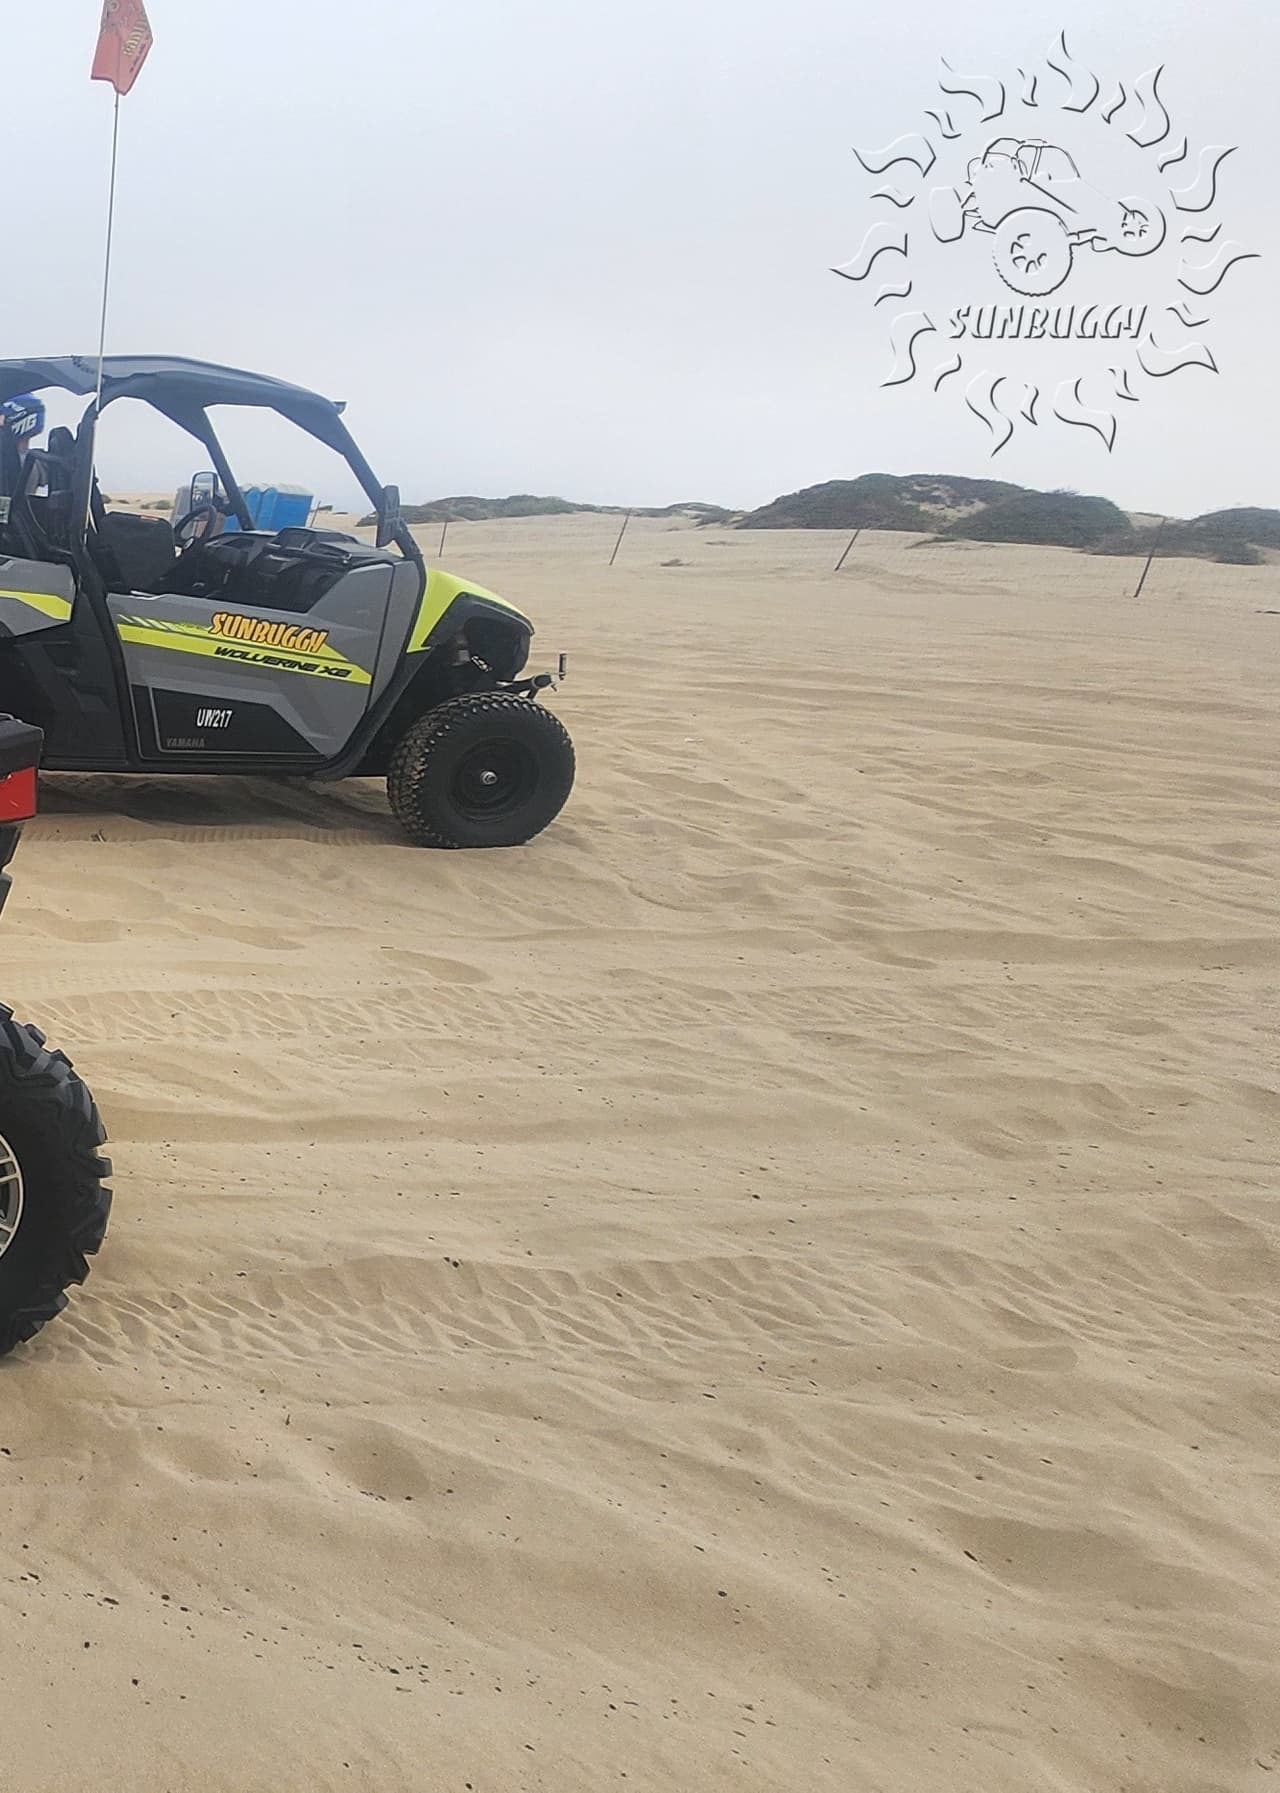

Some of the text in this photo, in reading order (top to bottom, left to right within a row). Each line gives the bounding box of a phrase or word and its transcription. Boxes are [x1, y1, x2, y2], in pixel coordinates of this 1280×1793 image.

[207, 612, 329, 653] SUNBUGGY
[213, 646, 318, 674] WOLVERINE
[196, 708, 233, 729] UW217
[166, 737, 205, 748] YAMAHA
